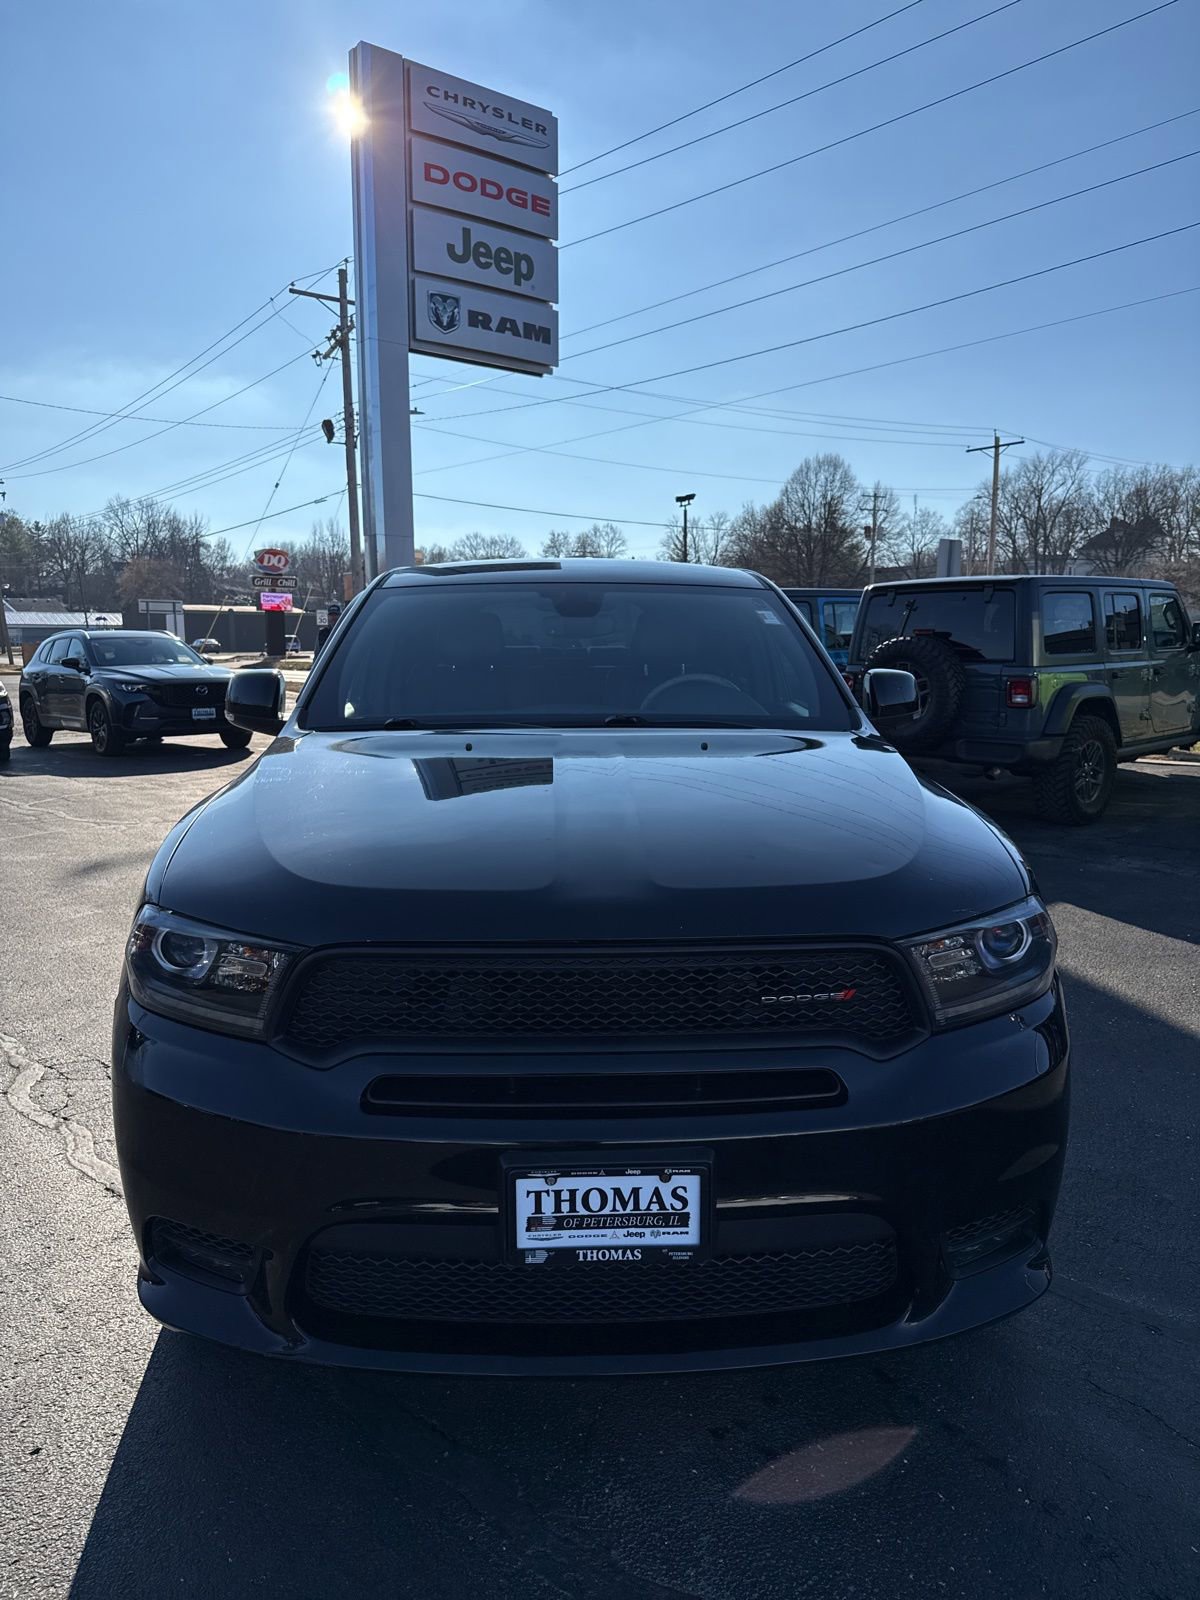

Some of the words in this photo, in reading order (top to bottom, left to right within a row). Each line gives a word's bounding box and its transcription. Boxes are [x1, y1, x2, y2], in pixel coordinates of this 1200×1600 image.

[426, 85, 548, 137] CHRYSLER
[424, 161, 551, 217] DODGE
[446, 226, 535, 287] Jeep
[467, 308, 552, 346] RAM
[263, 554, 286, 569] DQ
[254, 577, 272, 586] Grill
[277, 579, 296, 587] Chill
[761, 992, 844, 1003] DODGE
[526, 1185, 689, 1215] THOMAS
[563, 1216, 581, 1228] OF
[583, 1215, 666, 1228] PETERSBURG,
[669, 1215, 681, 1226] IL
[623, 1230, 646, 1239] Jeep
[576, 1249, 642, 1261] THOMAS
